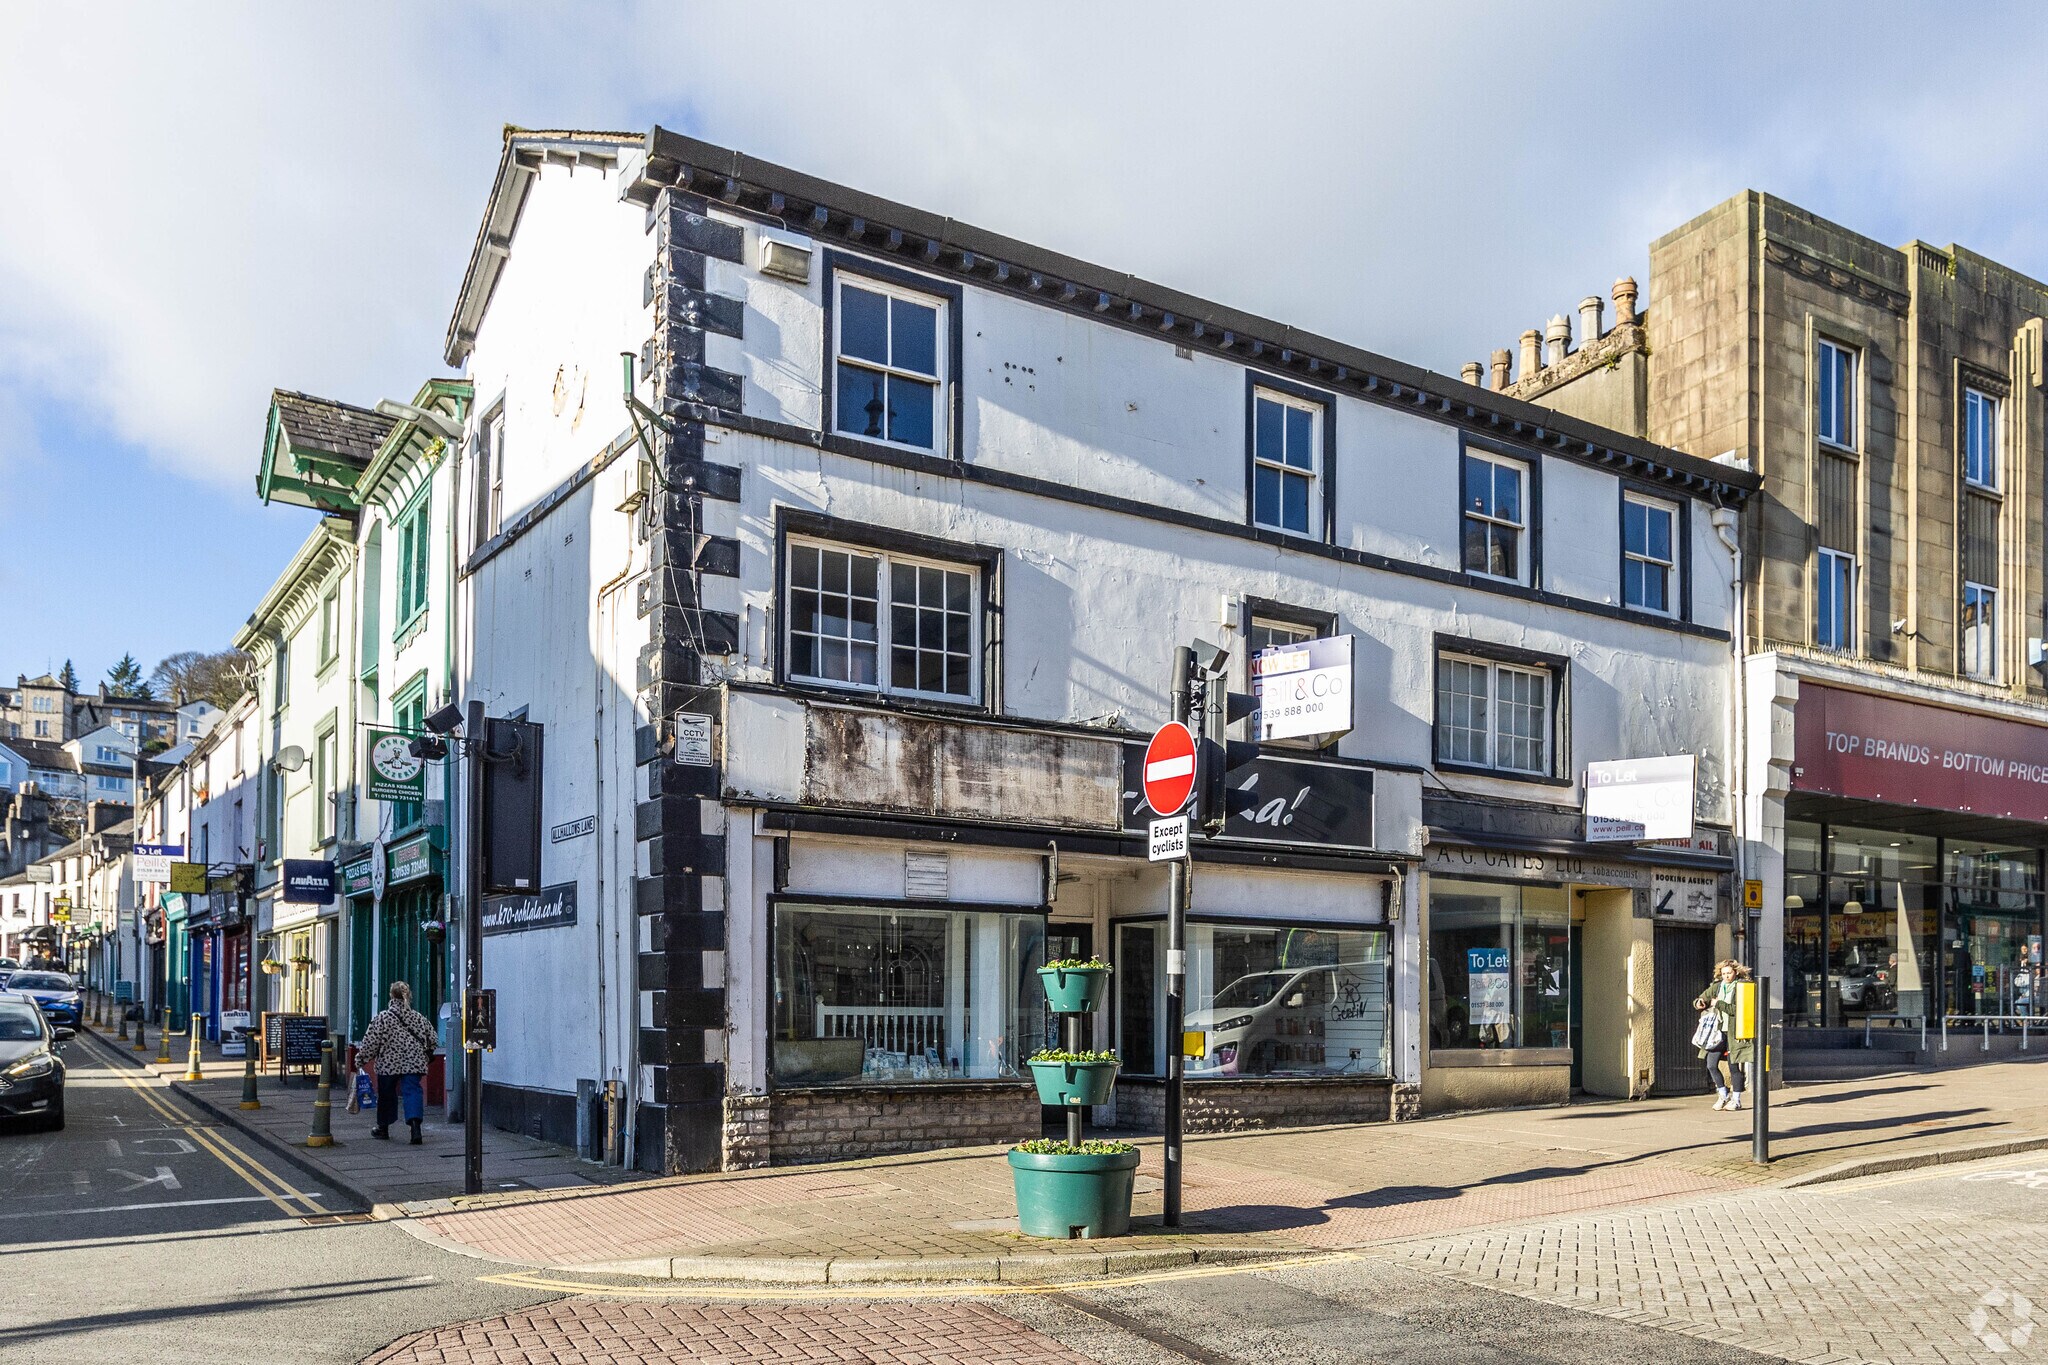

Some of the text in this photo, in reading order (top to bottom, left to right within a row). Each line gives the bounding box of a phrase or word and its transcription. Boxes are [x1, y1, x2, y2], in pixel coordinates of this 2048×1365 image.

[1284, 705, 1302, 717] 888
[1305, 702, 1324, 713] 000
[1826, 732, 1860, 753] TOP
[1864, 738, 1930, 765] BRANDS
[1942, 751, 2005, 776] BOTTOM
[378, 762, 417, 779] PIZZERIA
[1594, 769, 1638, 784] To Let
[552, 819, 593, 840] ALLHALLOWS LANE
[1154, 822, 1183, 840] Except
[1152, 839, 1184, 856] cyclists
[345, 866, 360, 881] PIZZAS
[1592, 866, 1639, 880] tobacconist
[1655, 874, 1686, 884] BOOKING
[290, 875, 330, 887] LAVAZZA
[1470, 954, 1507, 968] To Let
